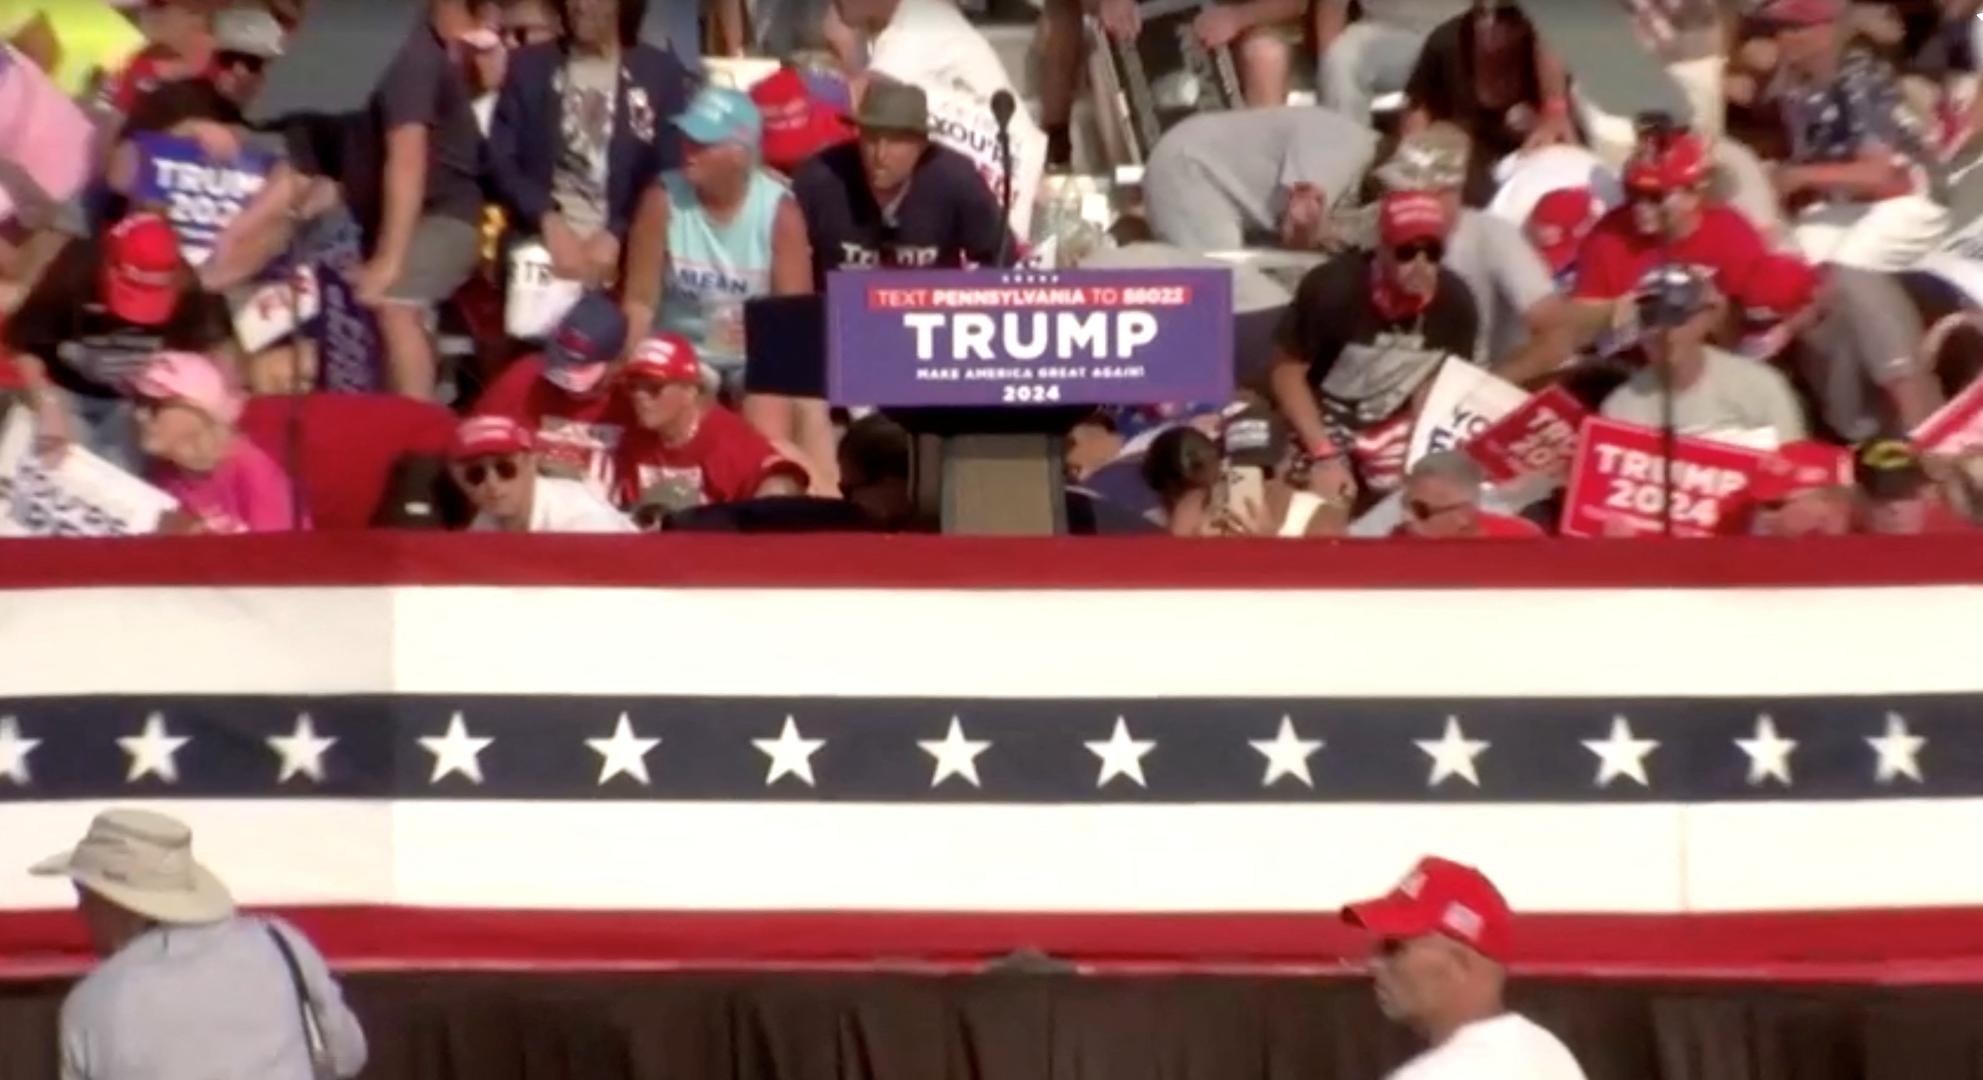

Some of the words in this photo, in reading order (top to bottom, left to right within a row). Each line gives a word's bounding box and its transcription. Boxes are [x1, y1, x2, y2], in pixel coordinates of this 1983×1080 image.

[680, 267, 748, 294] MEAN
[878, 289, 926, 306] TEXT
[932, 287, 1086, 306] PENNSYLVANIA
[1091, 287, 1118, 305] TO
[903, 311, 1158, 360] TRUMP
[916, 367, 960, 380] MAKE
[965, 367, 1033, 380] AMERICA
[1037, 366, 1087, 379] GREAT
[1091, 364, 1145, 379] AGAIN!
[1003, 385, 1061, 402] 2024
[1595, 442, 1748, 498] TRUMP
[1605, 477, 1719, 528] 2024
